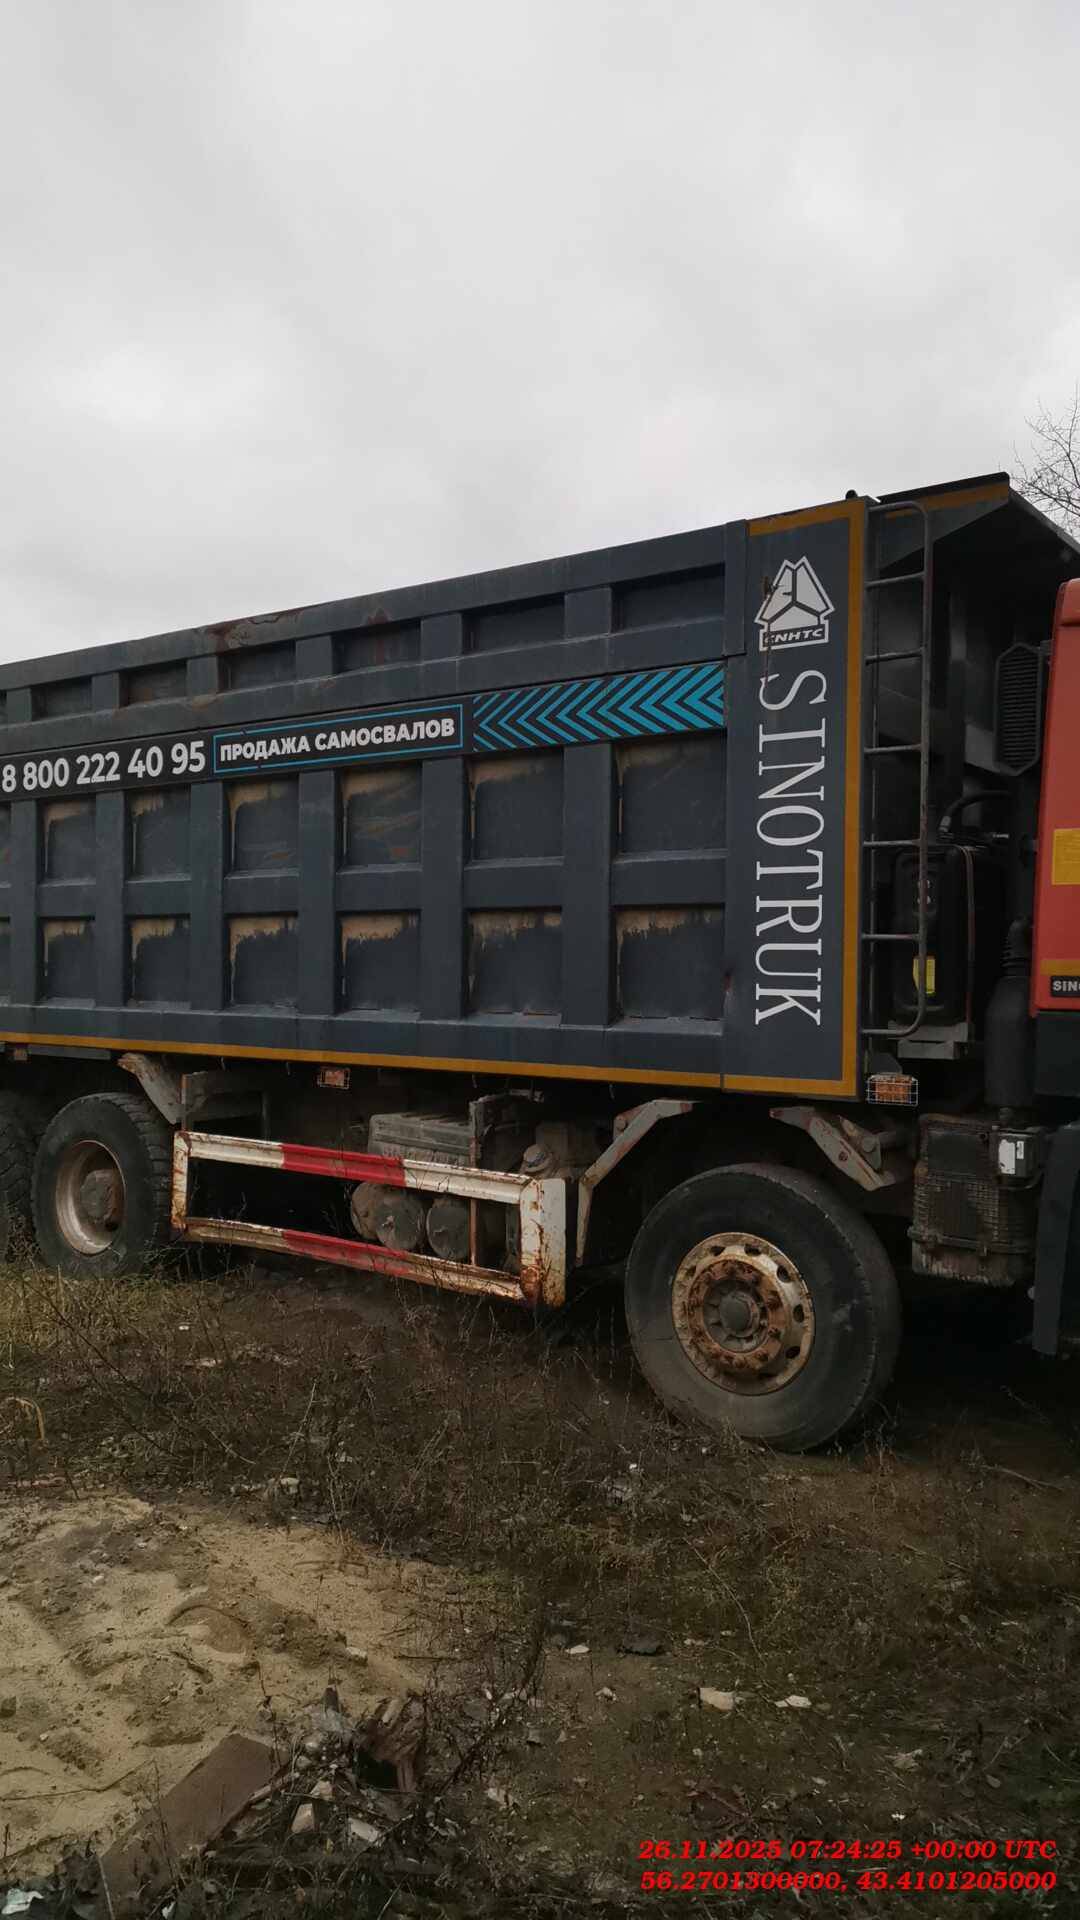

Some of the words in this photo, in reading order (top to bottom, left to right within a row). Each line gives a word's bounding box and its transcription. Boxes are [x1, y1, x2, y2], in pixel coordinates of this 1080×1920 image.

[220, 735, 311, 762] ПРОДАЖА
[314, 718, 456, 751] САМОСВАЛОВ
[1, 764, 17, 793] 8
[22, 757, 70, 791] 800
[75, 751, 121, 785] 222
[127, 745, 164, 778] 40
[171, 740, 206, 775] 95
[755, 669, 828, 1026] SINOTRUK
[1053, 980, 1080, 992] SIN
